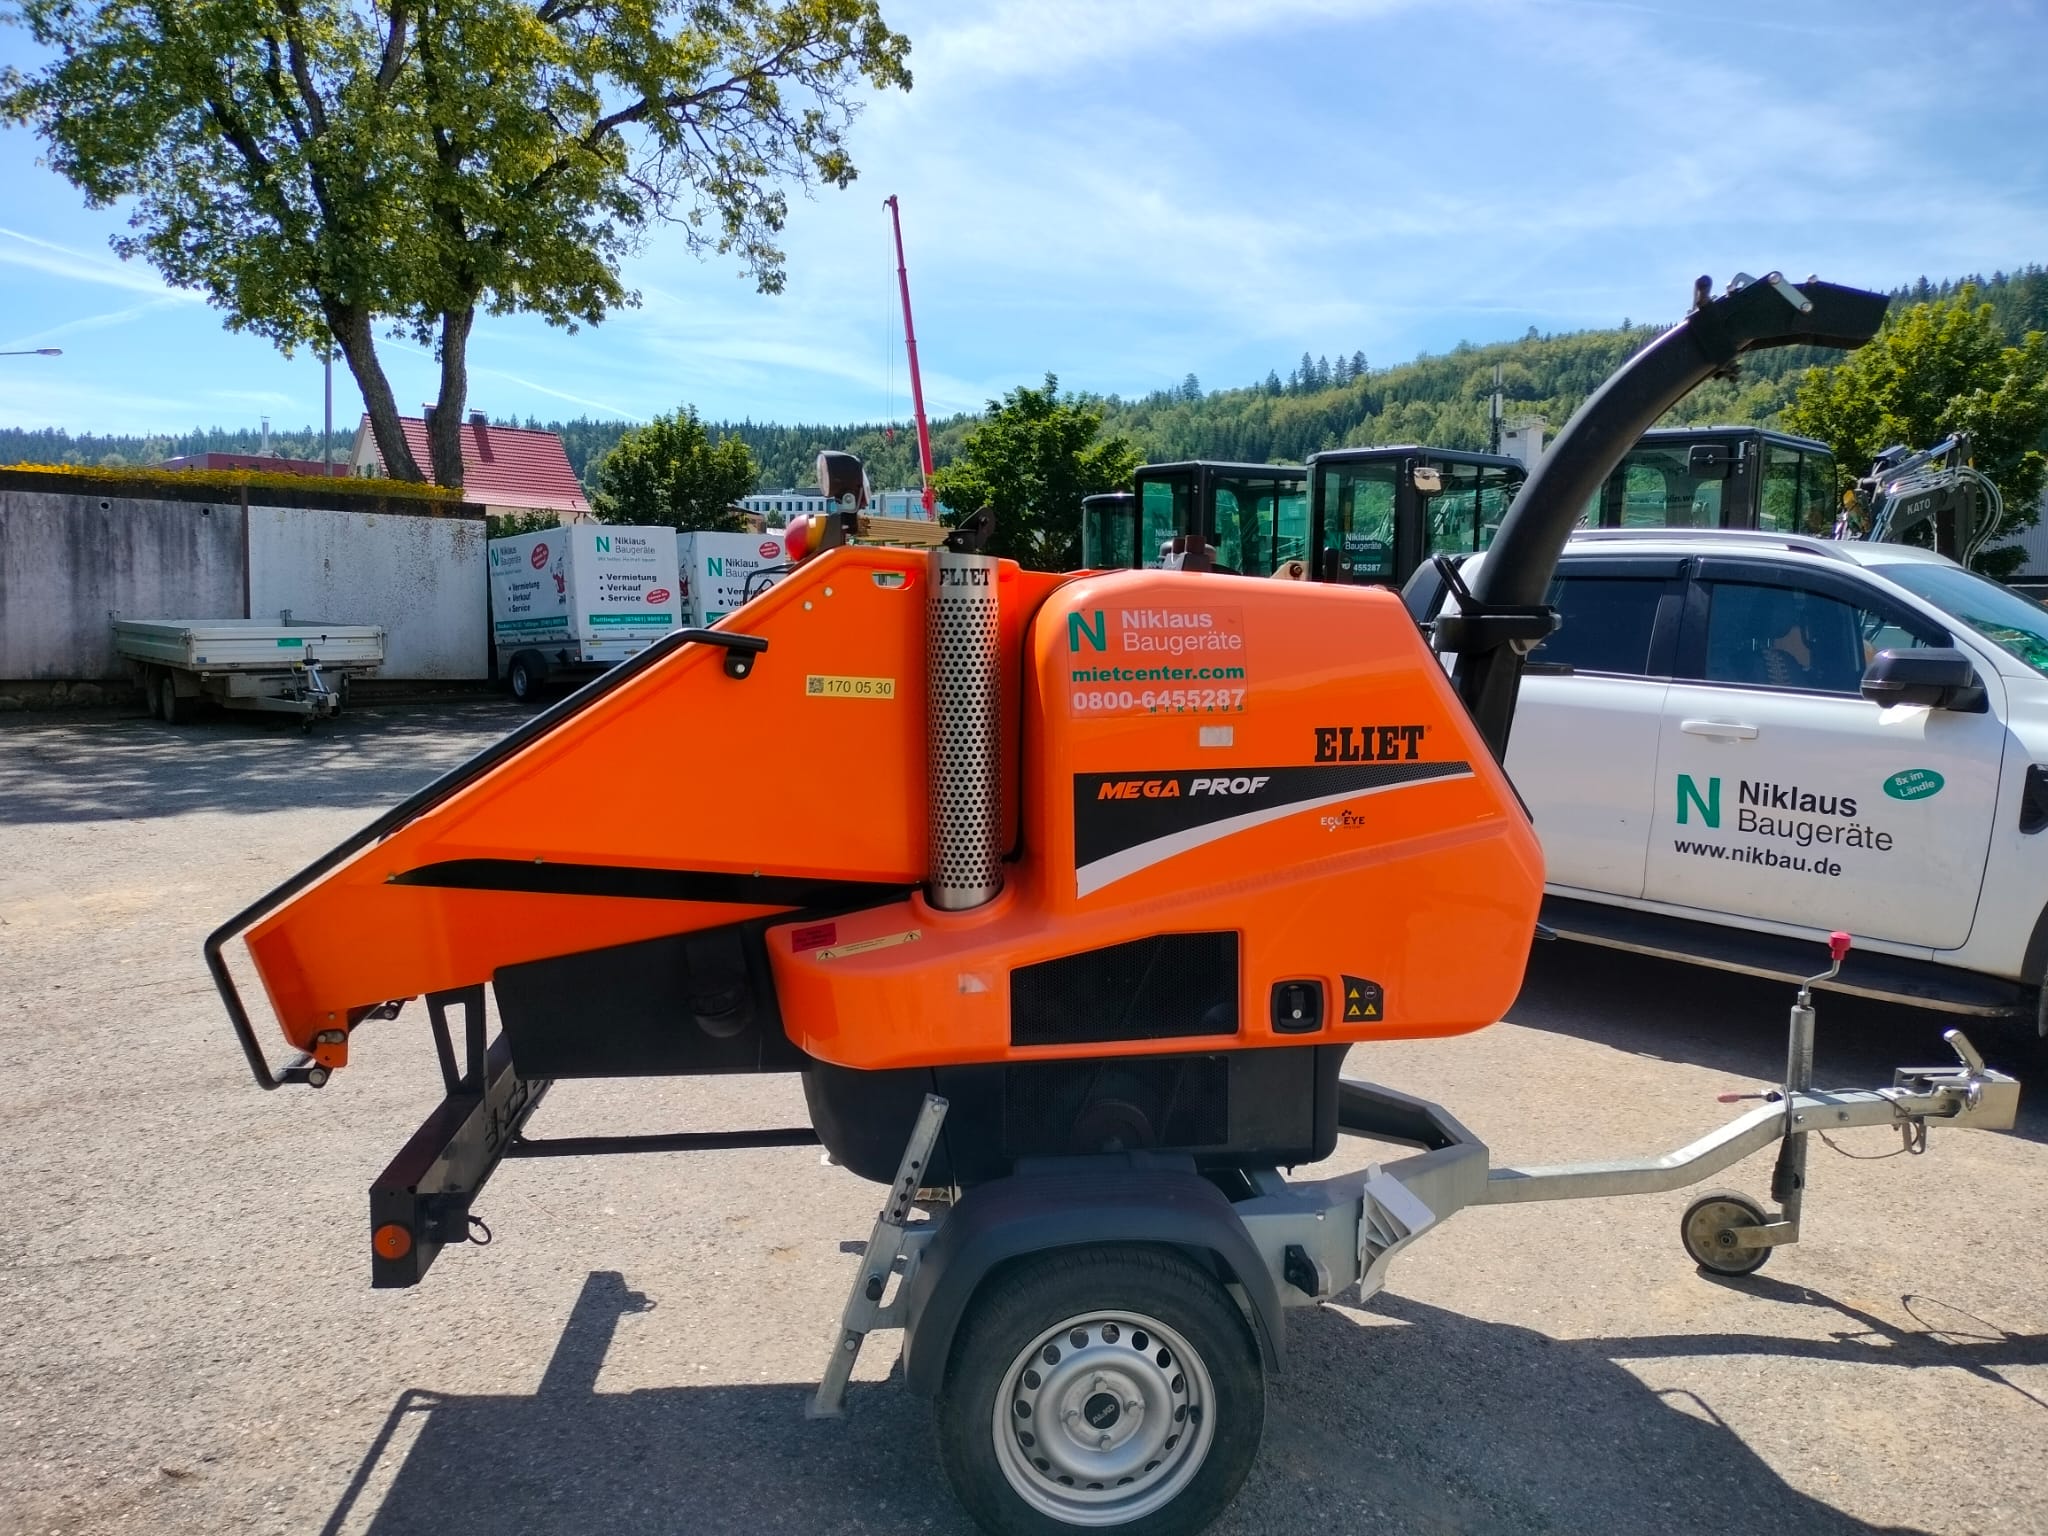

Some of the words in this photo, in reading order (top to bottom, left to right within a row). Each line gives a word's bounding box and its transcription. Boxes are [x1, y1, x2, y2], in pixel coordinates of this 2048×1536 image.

[1907, 498, 1930, 515] KATO
[596, 536, 610, 552] N
[615, 537, 646, 545] Niklaus
[1345, 542, 1382, 551] Baugeräte
[615, 545, 656, 555] Baugeräte
[707, 557, 723, 577] N
[725, 558, 759, 568] Niklaus
[1353, 564, 1381, 572] 455287
[606, 574, 657, 582] Vermietung
[608, 594, 641, 602] Service
[1121, 609, 1213, 629] Niklaus
[1067, 610, 1107, 652] N
[1123, 631, 1242, 656] Baugeräte
[1072, 666, 1245, 682] mietcenter.com
[827, 680, 851, 693] 170
[855, 681, 872, 694] 05
[875, 682, 892, 695] 30
[1072, 688, 1246, 710] 0800-6455287
[1314, 725, 1424, 763] ELIET
[1910, 772, 1924, 781] im
[1097, 779, 1180, 800] MEGA
[1188, 776, 1271, 797] PROF
[1899, 780, 1936, 797] Ländle
[1676, 773, 1721, 829] N
[1738, 779, 1857, 818] Niklaus
[1738, 808, 1893, 852] Baugeräte
[1674, 839, 1842, 877] www.nikbau.de
